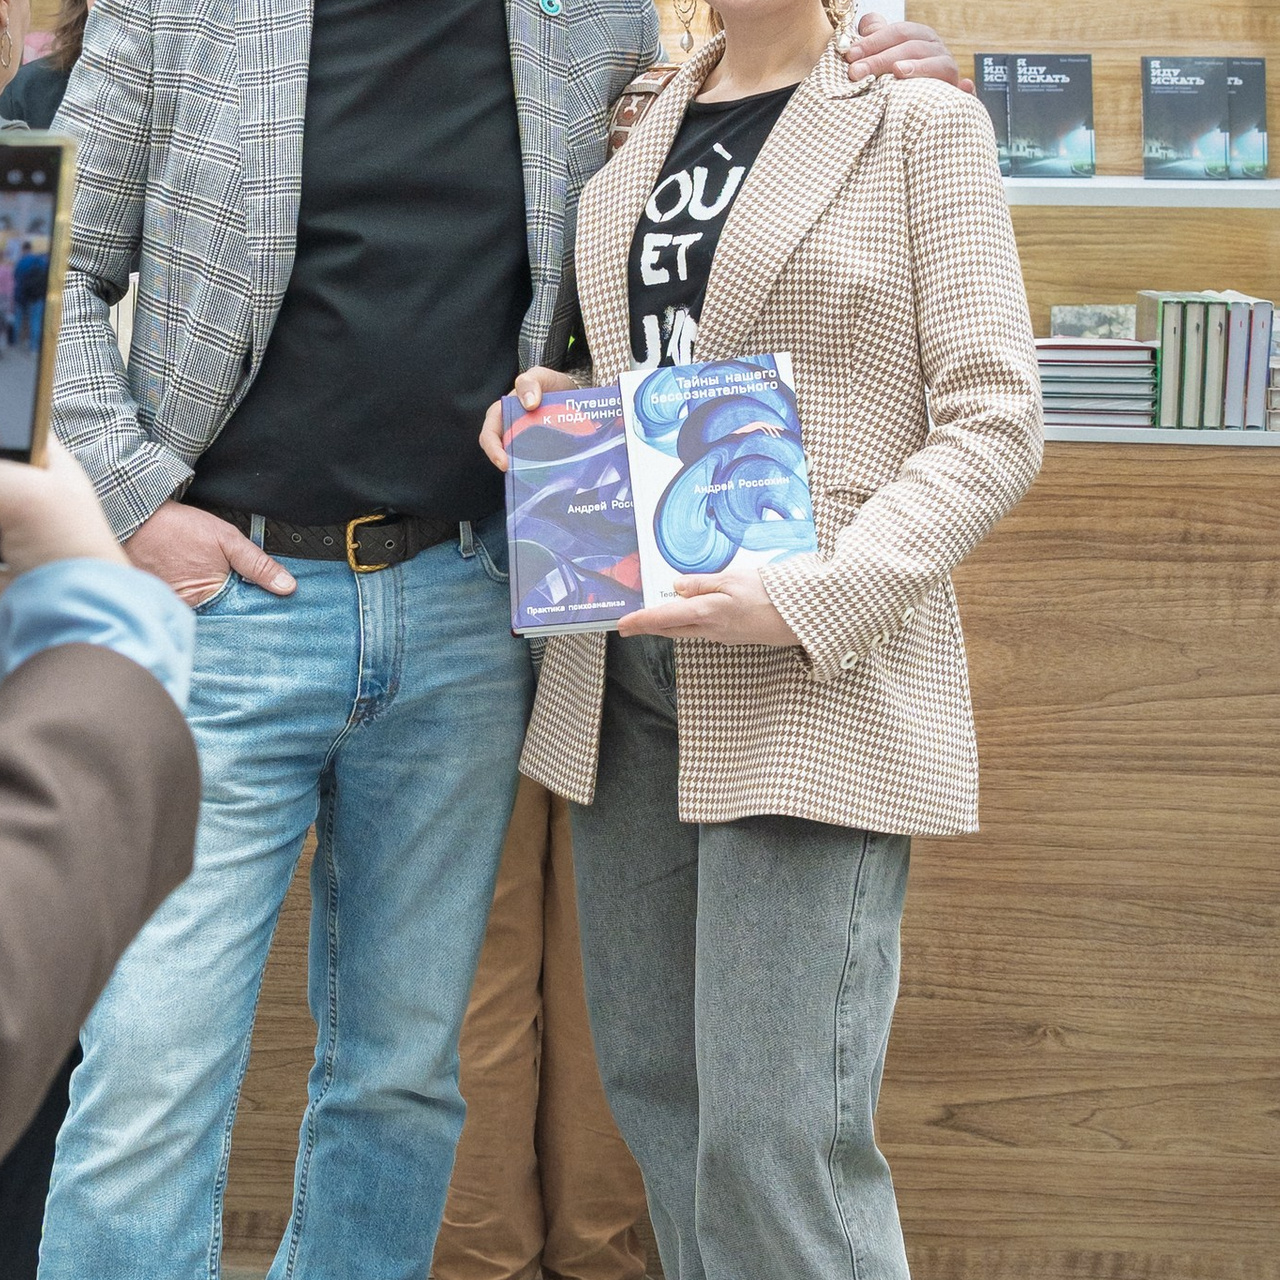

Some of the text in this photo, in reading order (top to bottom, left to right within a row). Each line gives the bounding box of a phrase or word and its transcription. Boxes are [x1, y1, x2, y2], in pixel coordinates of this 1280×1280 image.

[983, 57, 993, 66] Я
[1017, 58, 1027, 67] Я
[1151, 60, 1161, 69] Я
[1017, 66, 1047, 76] ИДУ
[1151, 68, 1181, 77] ИДУ
[1017, 74, 1070, 83] ИСКАТЬ
[1151, 76, 1205, 86] ИСКАТЬ
[641, 232, 703, 286] ET
[675, 369, 778, 390] Тайны нашего
[650, 379, 779, 405] бессознательного
[693, 476, 791, 495] Андрей Россохин
[567, 499, 608, 514] Андрей
[527, 599, 626, 615] Практика психоанализа
